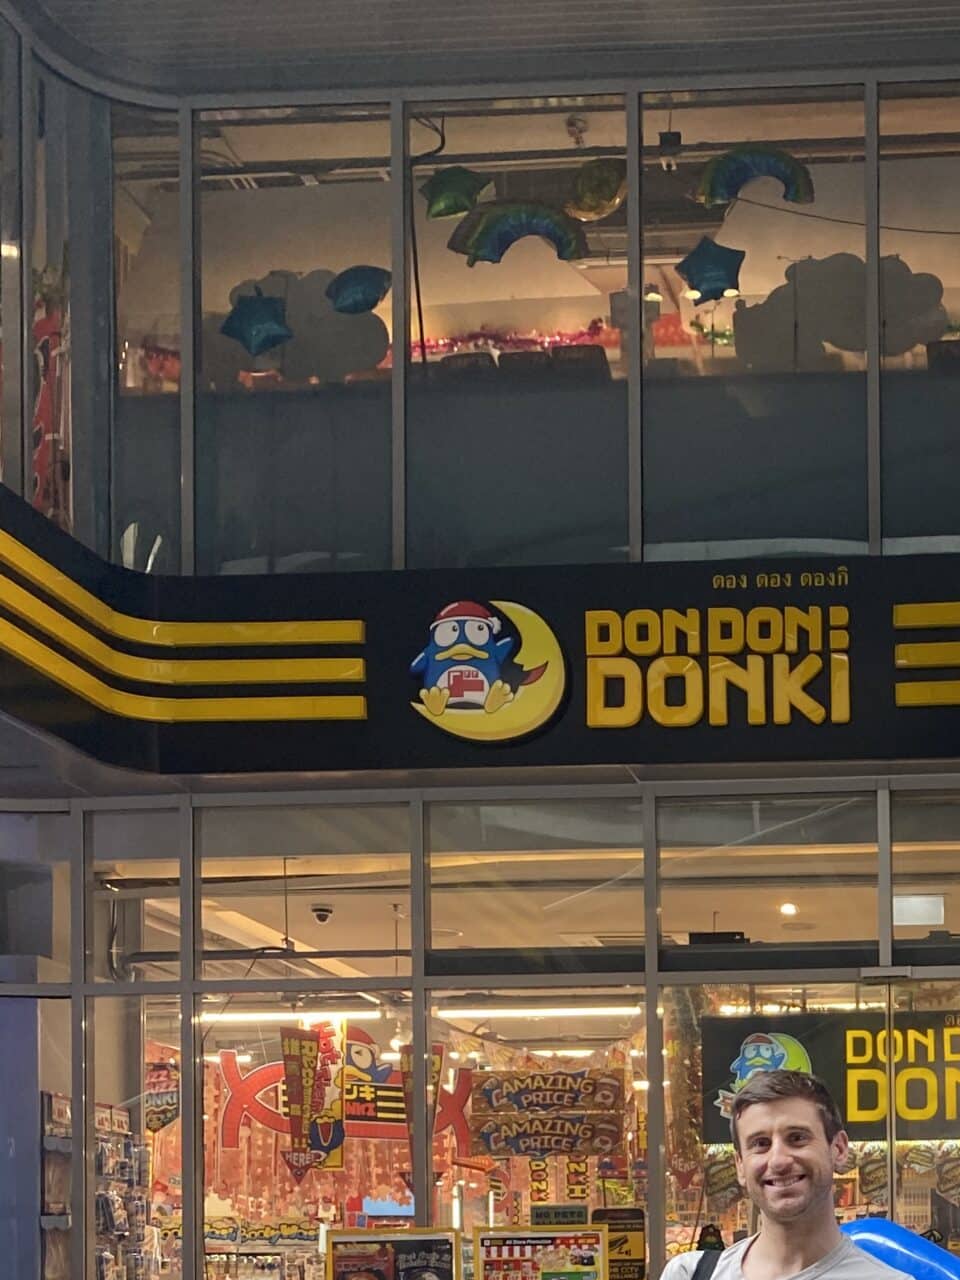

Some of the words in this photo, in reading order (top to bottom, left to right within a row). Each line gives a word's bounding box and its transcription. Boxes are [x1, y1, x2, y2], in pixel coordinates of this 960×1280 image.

[712, 574, 748, 589] ดอง
[755, 572, 793, 588] ดอง
[585, 608, 700, 657] DON
[708, 606, 823, 654] DON
[846, 1030, 935, 1063] DON
[502, 1074, 595, 1096] AMAZING
[520, 1091, 576, 1108] PRICE
[500, 1117, 593, 1140] AMAZING
[518, 1135, 575, 1152] PRICE
